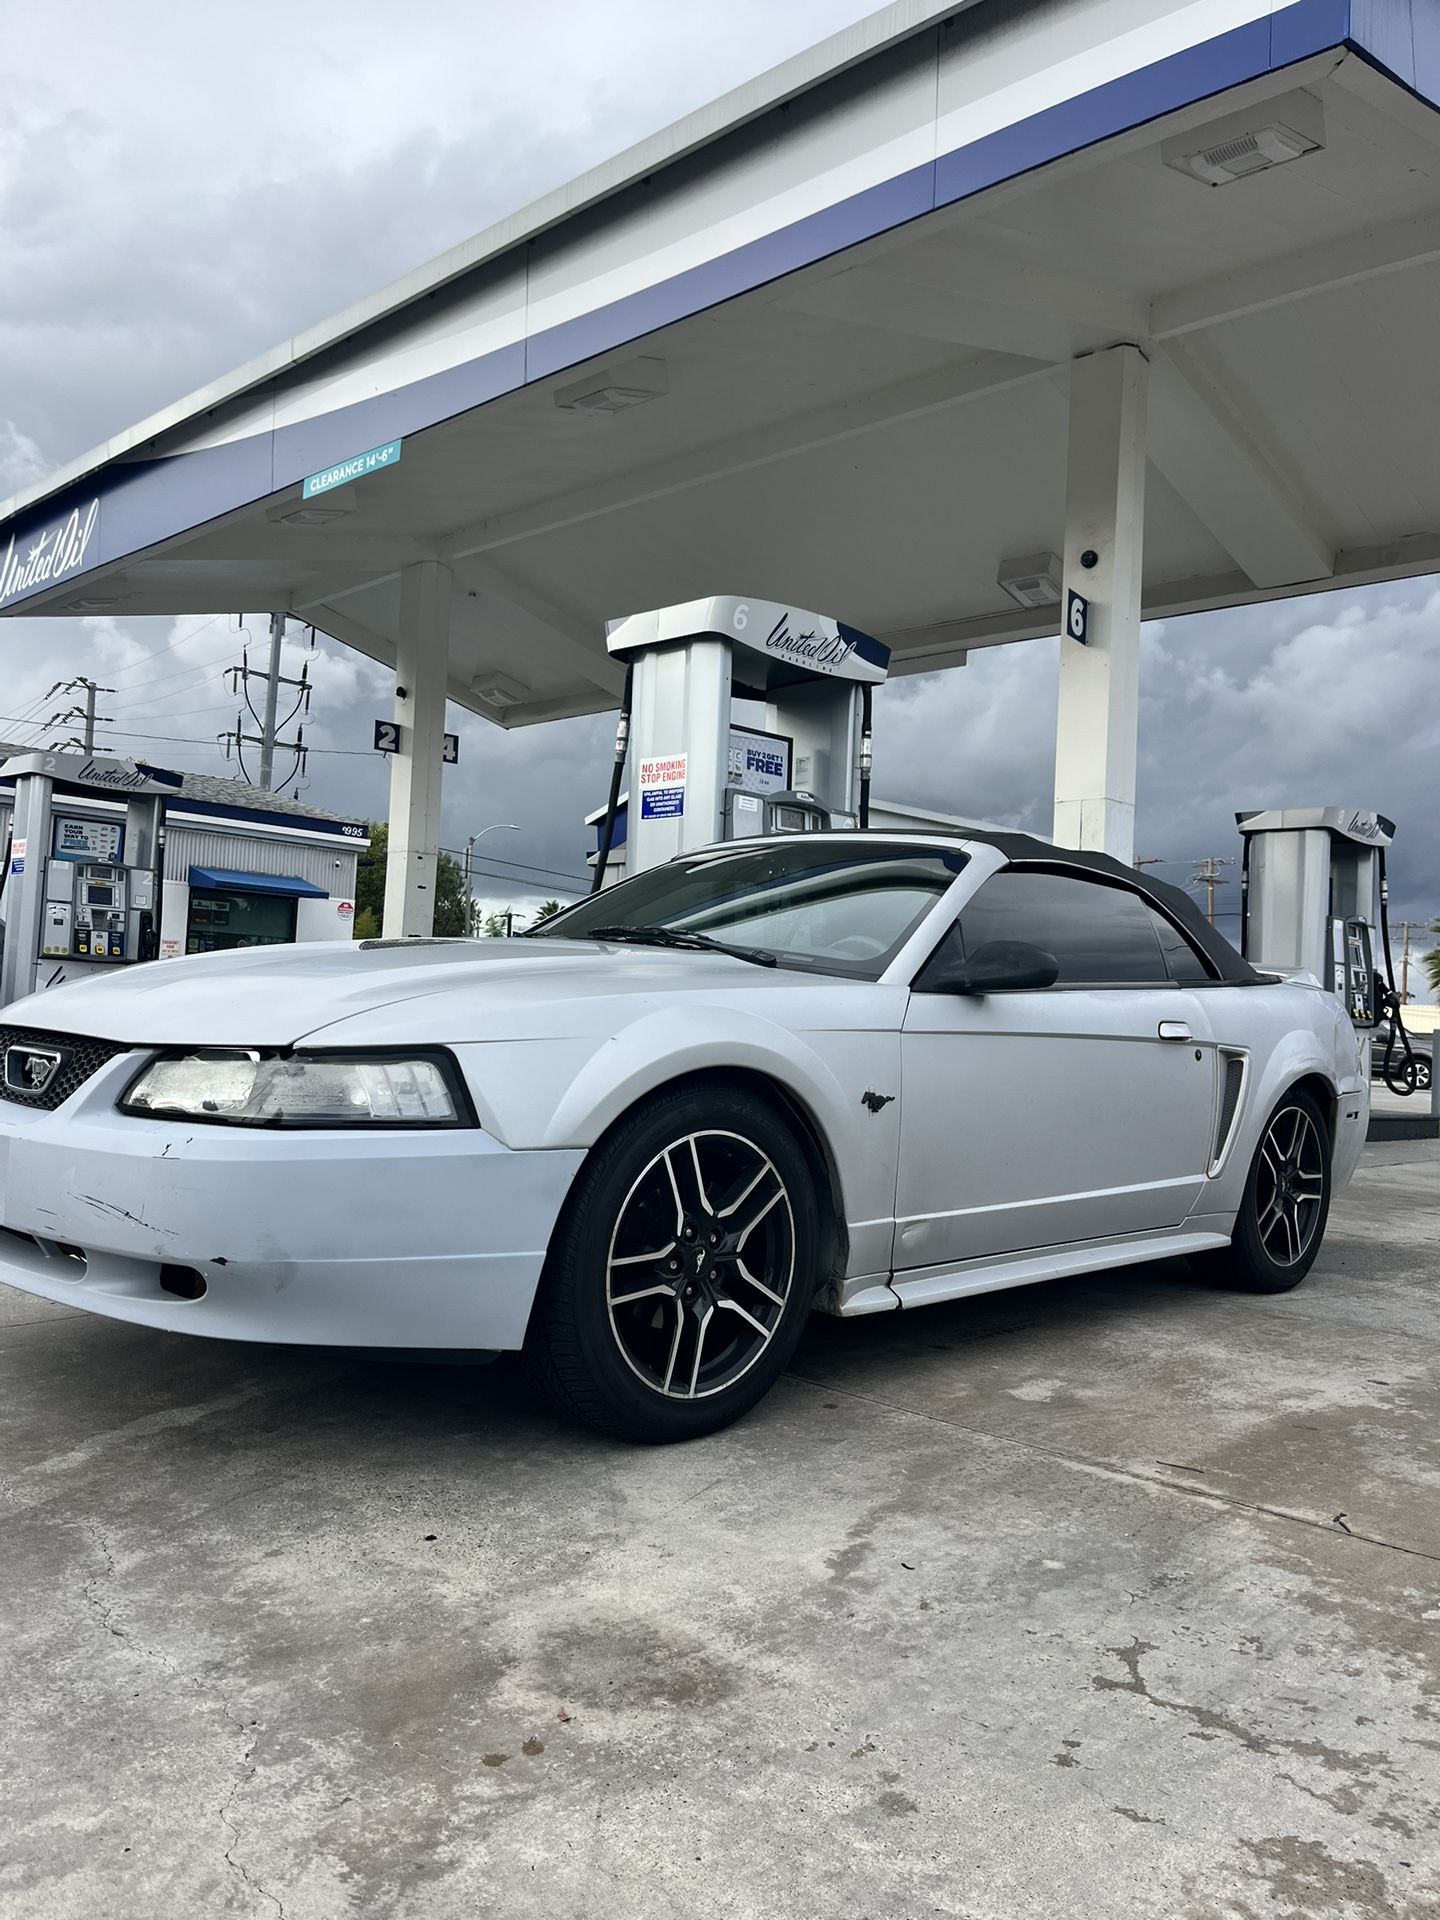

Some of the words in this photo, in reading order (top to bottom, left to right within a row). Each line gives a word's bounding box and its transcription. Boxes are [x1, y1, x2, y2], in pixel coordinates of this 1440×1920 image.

[310, 458, 364, 491] CLEARANCE
[0, 530, 62, 601] United
[52, 497, 100, 578] Oil
[733, 604, 749, 630] 6
[1070, 598, 1084, 637] 6
[766, 612, 828, 657] United
[817, 635, 858, 664] Oil
[379, 724, 396, 750] 2
[443, 736, 456, 760] 4
[44, 757, 57, 772] 2
[746, 749, 762, 757] BUY
[78, 759, 126, 784] United
[120, 769, 154, 788] Oil
[641, 772, 661, 784] STOP
[662, 769, 685, 781] ENGINE
[642, 763, 653, 773] NO
[655, 760, 685, 772] SMOKING
[746, 756, 783, 777] FREE
[64, 823, 84, 831] EARN
[143, 872, 153, 885] 2
